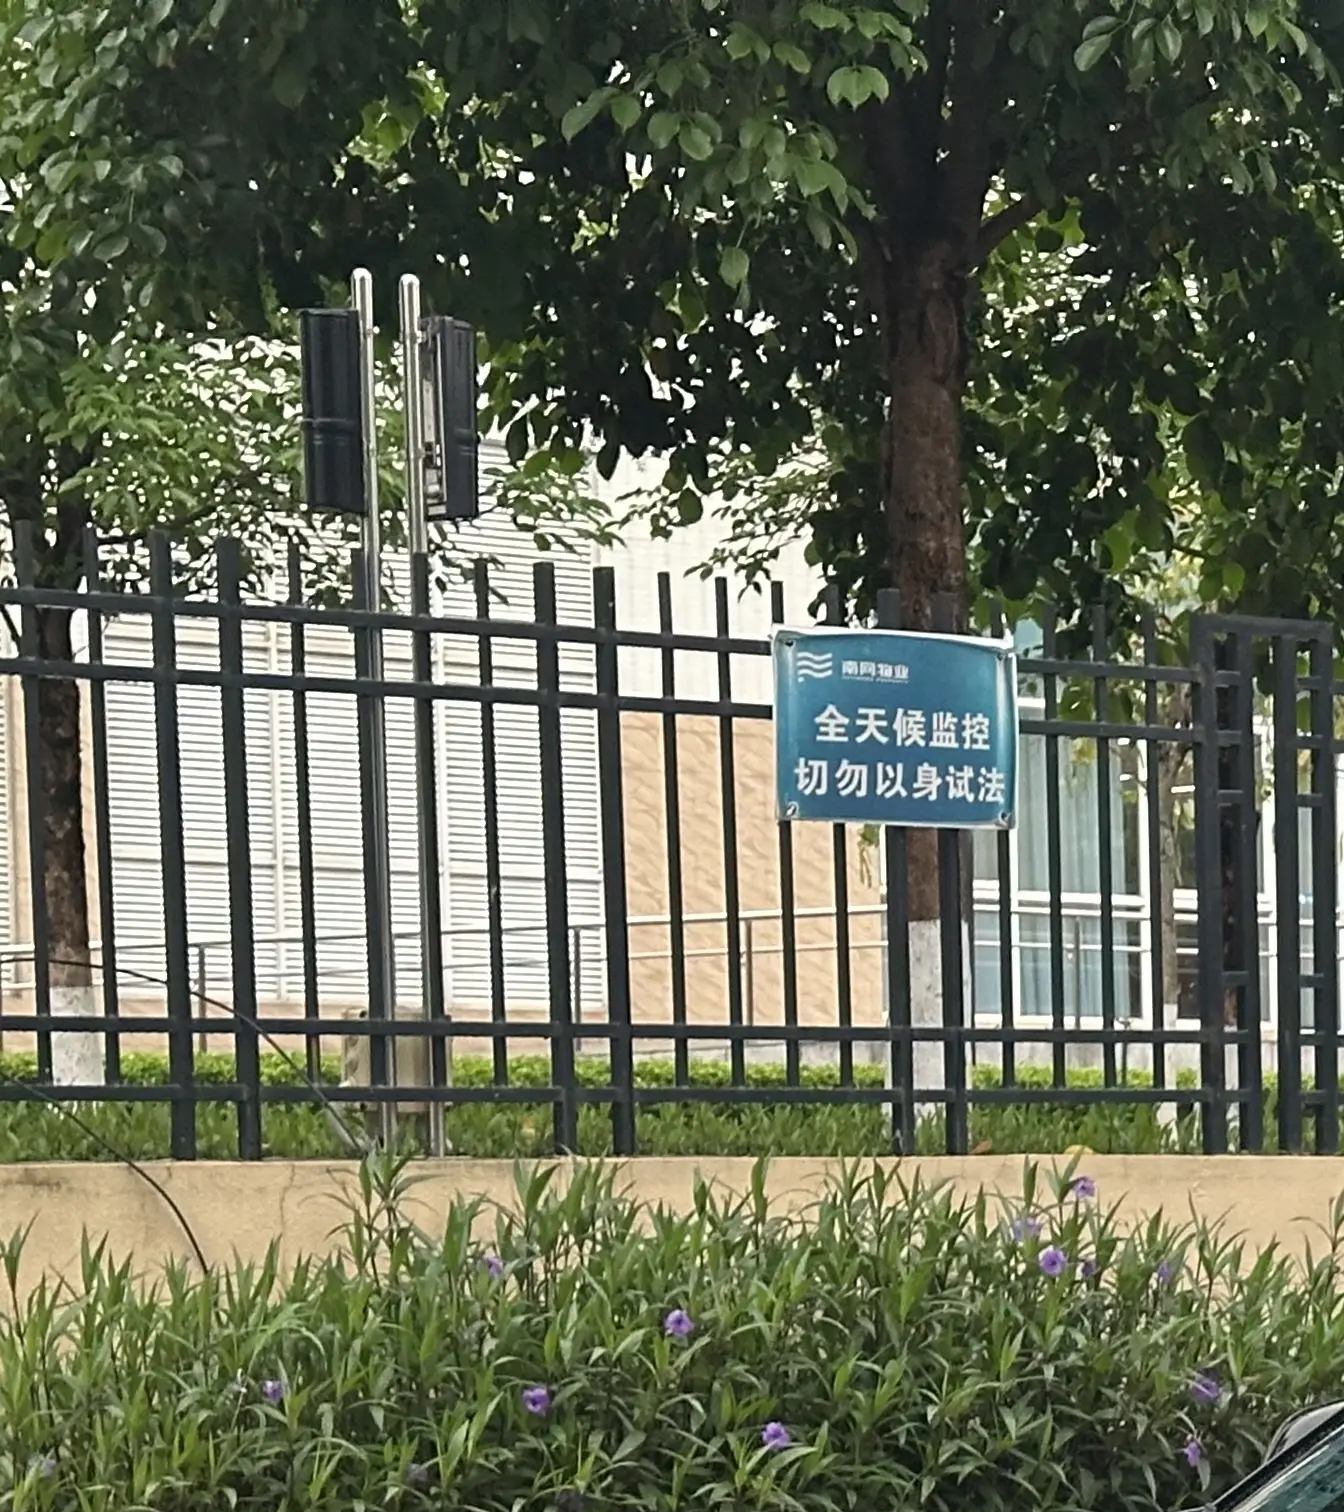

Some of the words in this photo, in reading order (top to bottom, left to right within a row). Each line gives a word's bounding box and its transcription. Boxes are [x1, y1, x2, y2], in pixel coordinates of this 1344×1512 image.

[814, 704, 991, 750] 全天候监控
[794, 757, 1006, 803] 切勿以身试法
